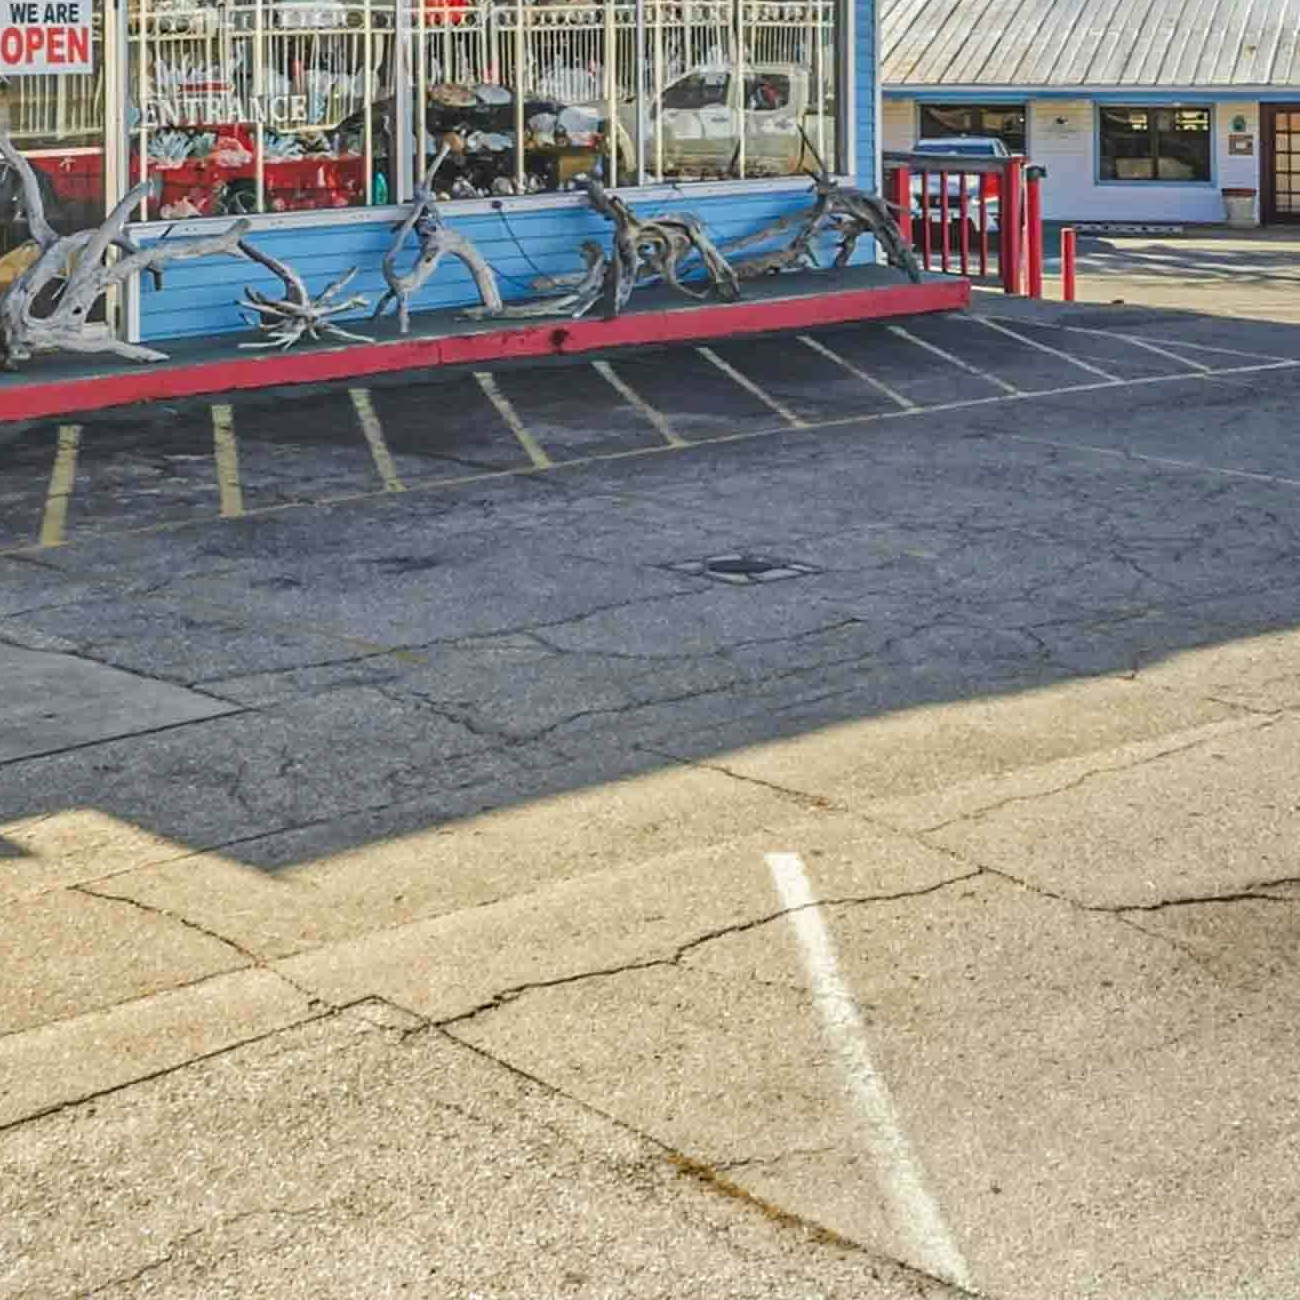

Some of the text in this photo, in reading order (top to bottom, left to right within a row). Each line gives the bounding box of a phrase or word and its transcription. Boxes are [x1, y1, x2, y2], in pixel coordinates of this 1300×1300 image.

[9, 2, 79, 25] WE ARE
[0, 27, 89, 67] OPEN
[141, 93, 308, 127] ENTRANCE
